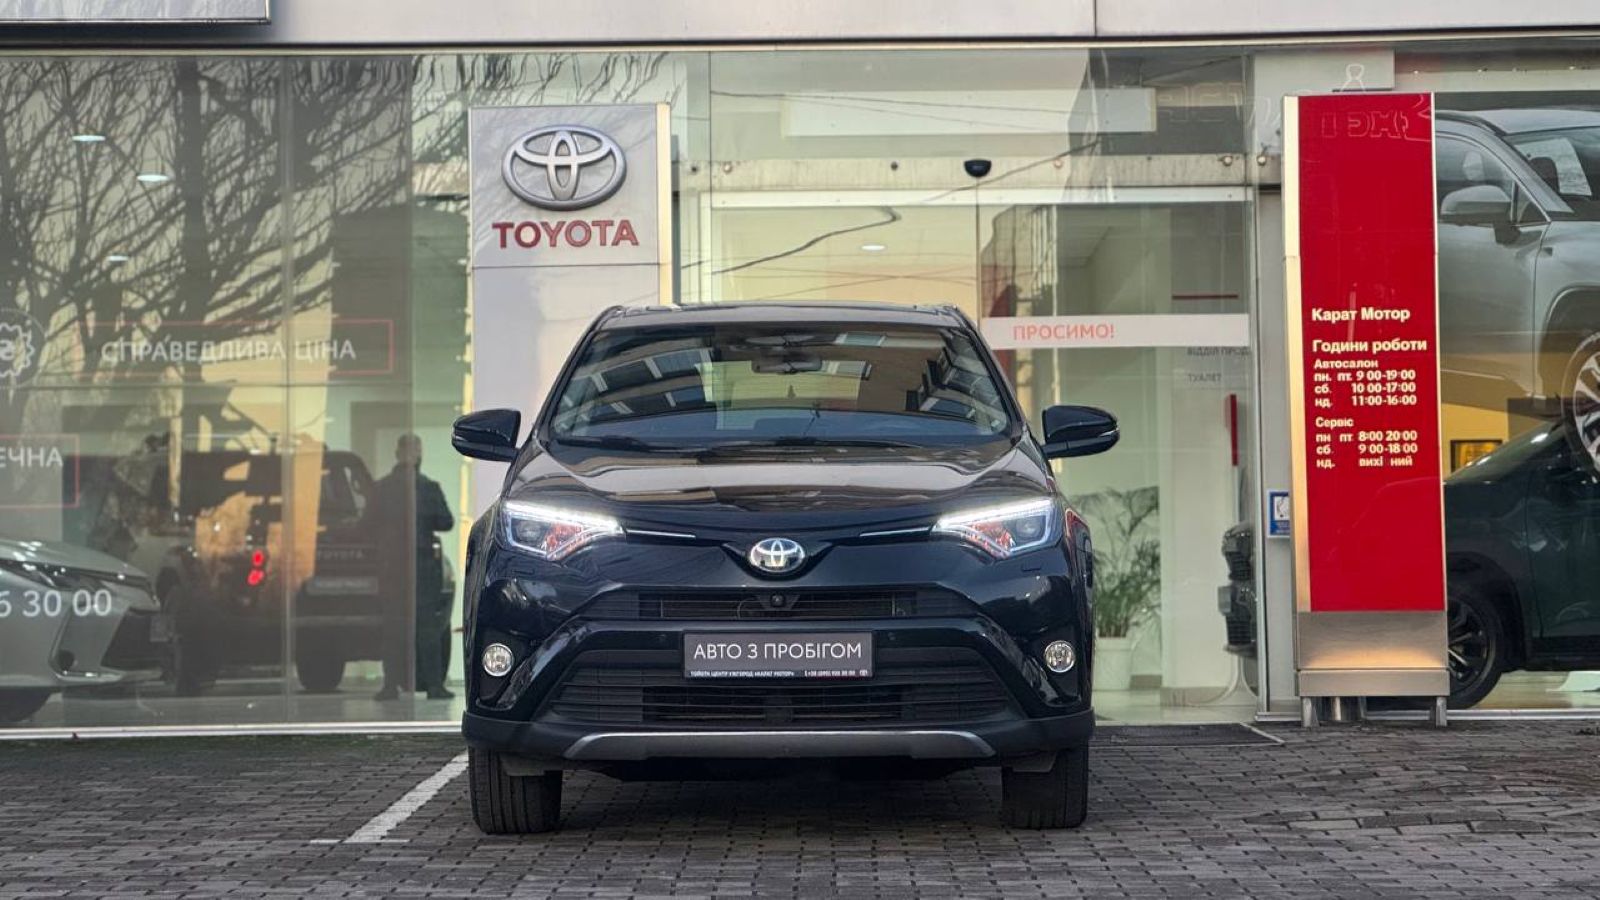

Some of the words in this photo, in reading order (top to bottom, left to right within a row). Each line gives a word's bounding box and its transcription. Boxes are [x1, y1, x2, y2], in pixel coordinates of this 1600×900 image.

[492, 219, 639, 249] TOYOTA
[1311, 308, 1357, 323] Карат
[1361, 307, 1411, 323] Мотор
[1013, 323, 1116, 341] ПРОСИМО!
[101, 340, 287, 363] СПРАВЕДЛИВА
[295, 340, 357, 362] ЦІНА
[1312, 340, 1368, 354] Години
[1372, 338, 1428, 354] роботи
[1314, 359, 1379, 370] Автосалон
[1315, 416, 1354, 429] Сервіс
[21, 588, 62, 618] 30
[72, 588, 113, 618] 00
[693, 643, 742, 659] АВТО
[747, 643, 758, 659] З
[764, 642, 863, 659] ПРОБІГОМ
